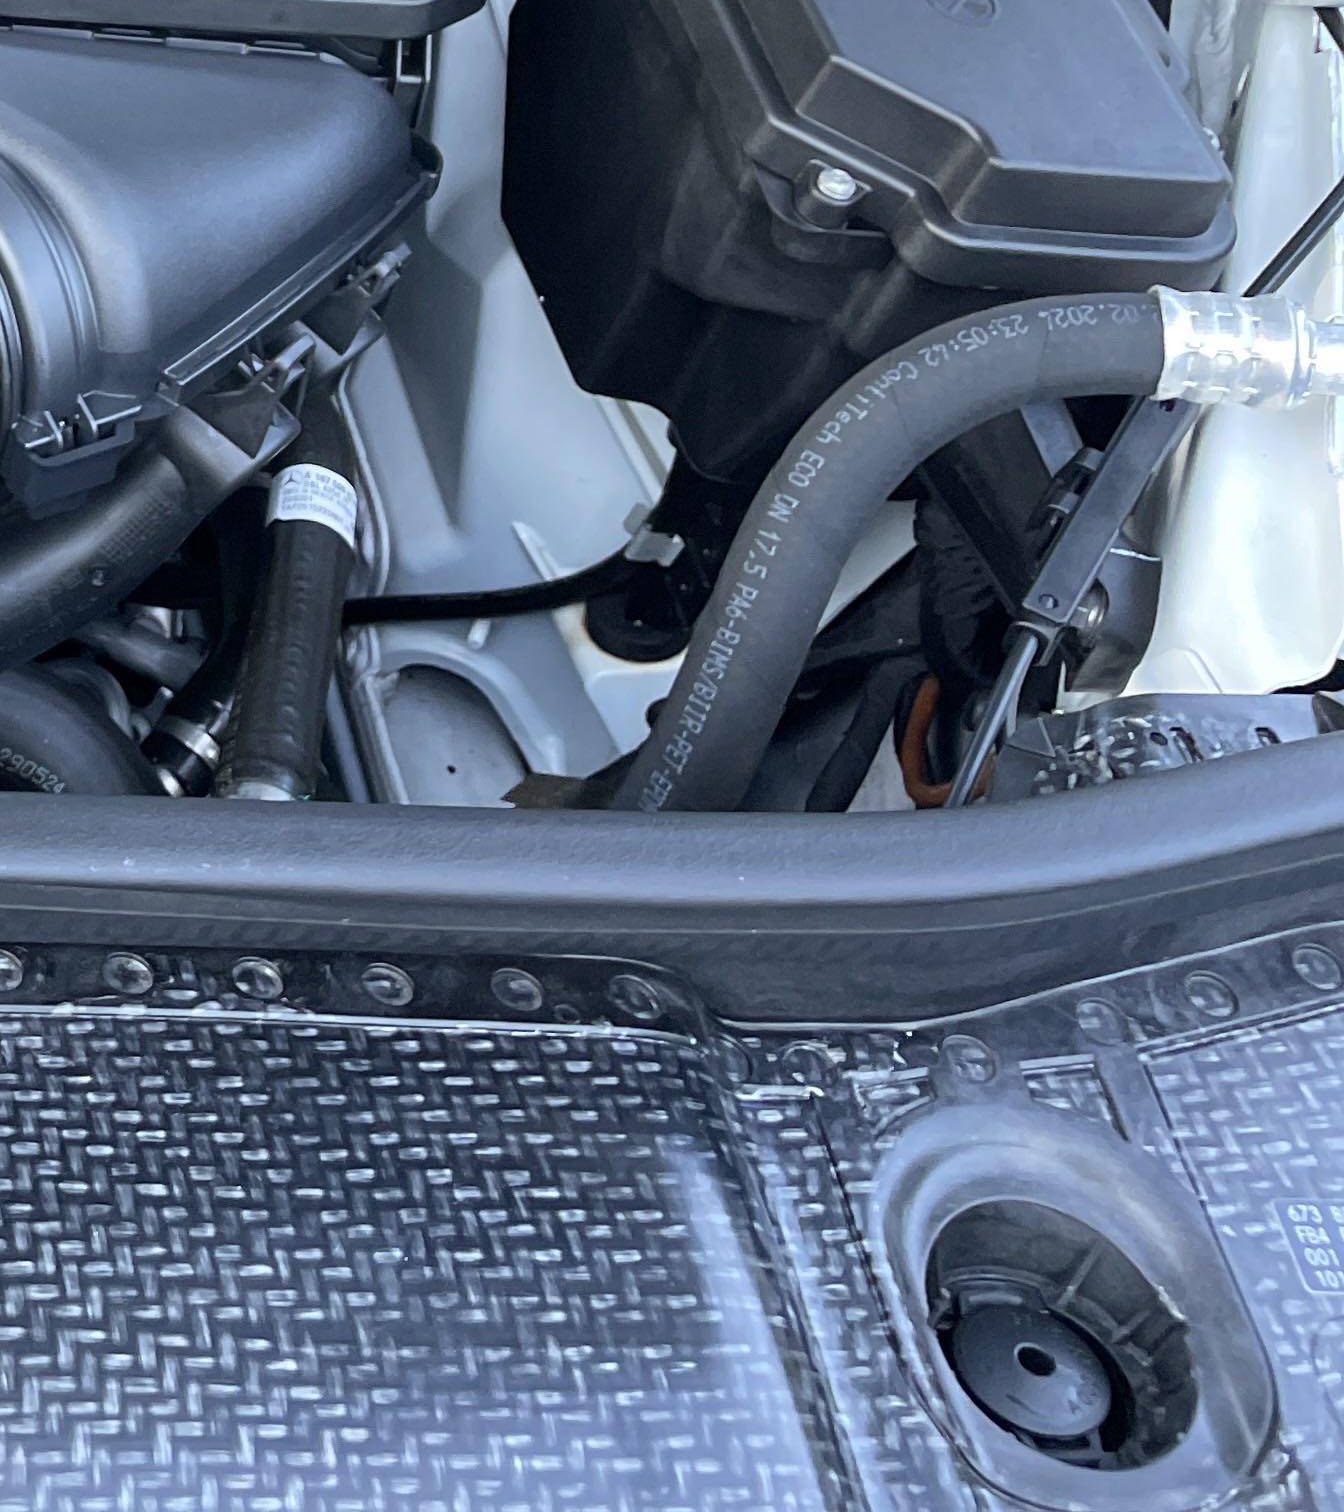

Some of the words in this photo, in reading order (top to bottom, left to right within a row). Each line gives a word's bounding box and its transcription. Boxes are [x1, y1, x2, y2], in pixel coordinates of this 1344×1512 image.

[918, 313, 1029, 368] 23:05:42
[815, 360, 921, 444] ContiTech
[787, 449, 826, 489] ECO
[1304, 1247, 1340, 1267] 001
